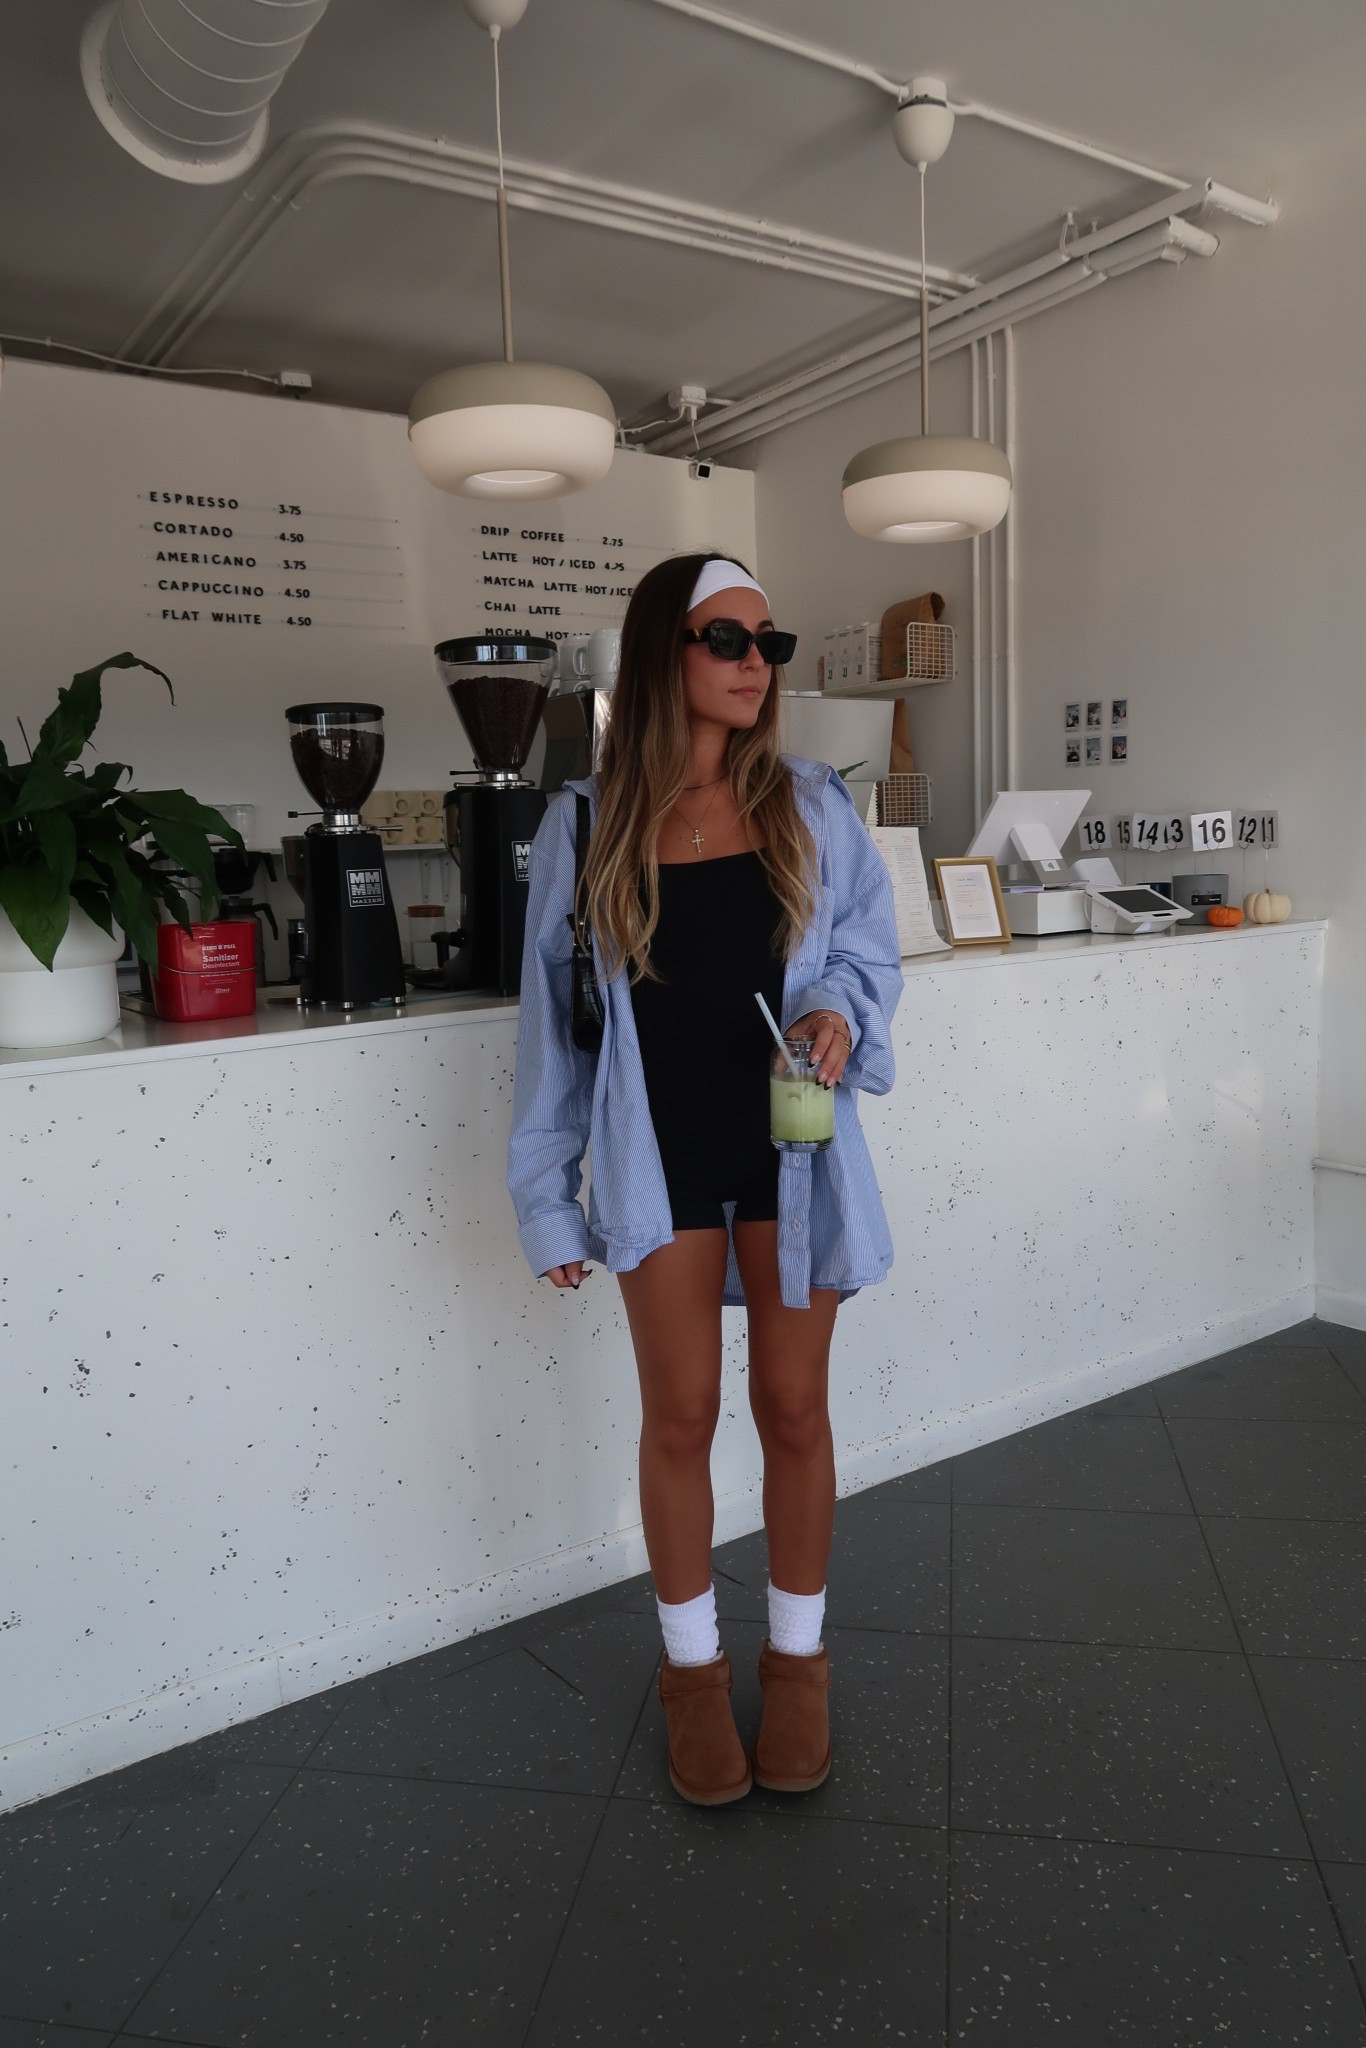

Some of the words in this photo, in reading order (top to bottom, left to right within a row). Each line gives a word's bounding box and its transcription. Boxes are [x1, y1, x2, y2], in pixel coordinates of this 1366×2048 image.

[150, 491, 238, 509] ESPRESSO
[279, 504, 301, 515] 3.75
[154, 522, 232, 538] CORTADO
[279, 533, 304, 543] 4.50
[481, 526, 509, 536] DRIP
[521, 530, 564, 542] COFFEE
[603, 537, 623, 547] 2.75
[156, 551, 256, 567] AMERICANO
[284, 560, 306, 570] 3.75
[483, 551, 517, 562] LATTE
[533, 556, 555, 566] HOT
[570, 560, 595, 569] ICED
[158, 580, 263, 597] CAPPUCCINO
[285, 588, 310, 598] 4.50
[484, 576, 534, 588] MATCHA
[544, 582, 577, 592] LATTE
[586, 585, 607, 594] HOT
[615, 587, 634, 597] ICE
[162, 610, 199, 621] FLAT
[212, 612, 261, 624] WHITE
[287, 617, 311, 626] 4.50
[485, 601, 515, 612] CHAI
[529, 605, 561, 615] LATTE
[485, 628, 531, 636] MOCHA
[545, 631, 569, 640] HOT
[1083, 820, 1106, 844] 18
[1117, 821, 1130, 843] 15
[1137, 820, 1159, 845] 14
[1198, 818, 1226, 844] 16
[1239, 816, 1257, 843] 12
[1262, 817, 1274, 842] 11
[202, 954, 239, 962] Sanitizer
